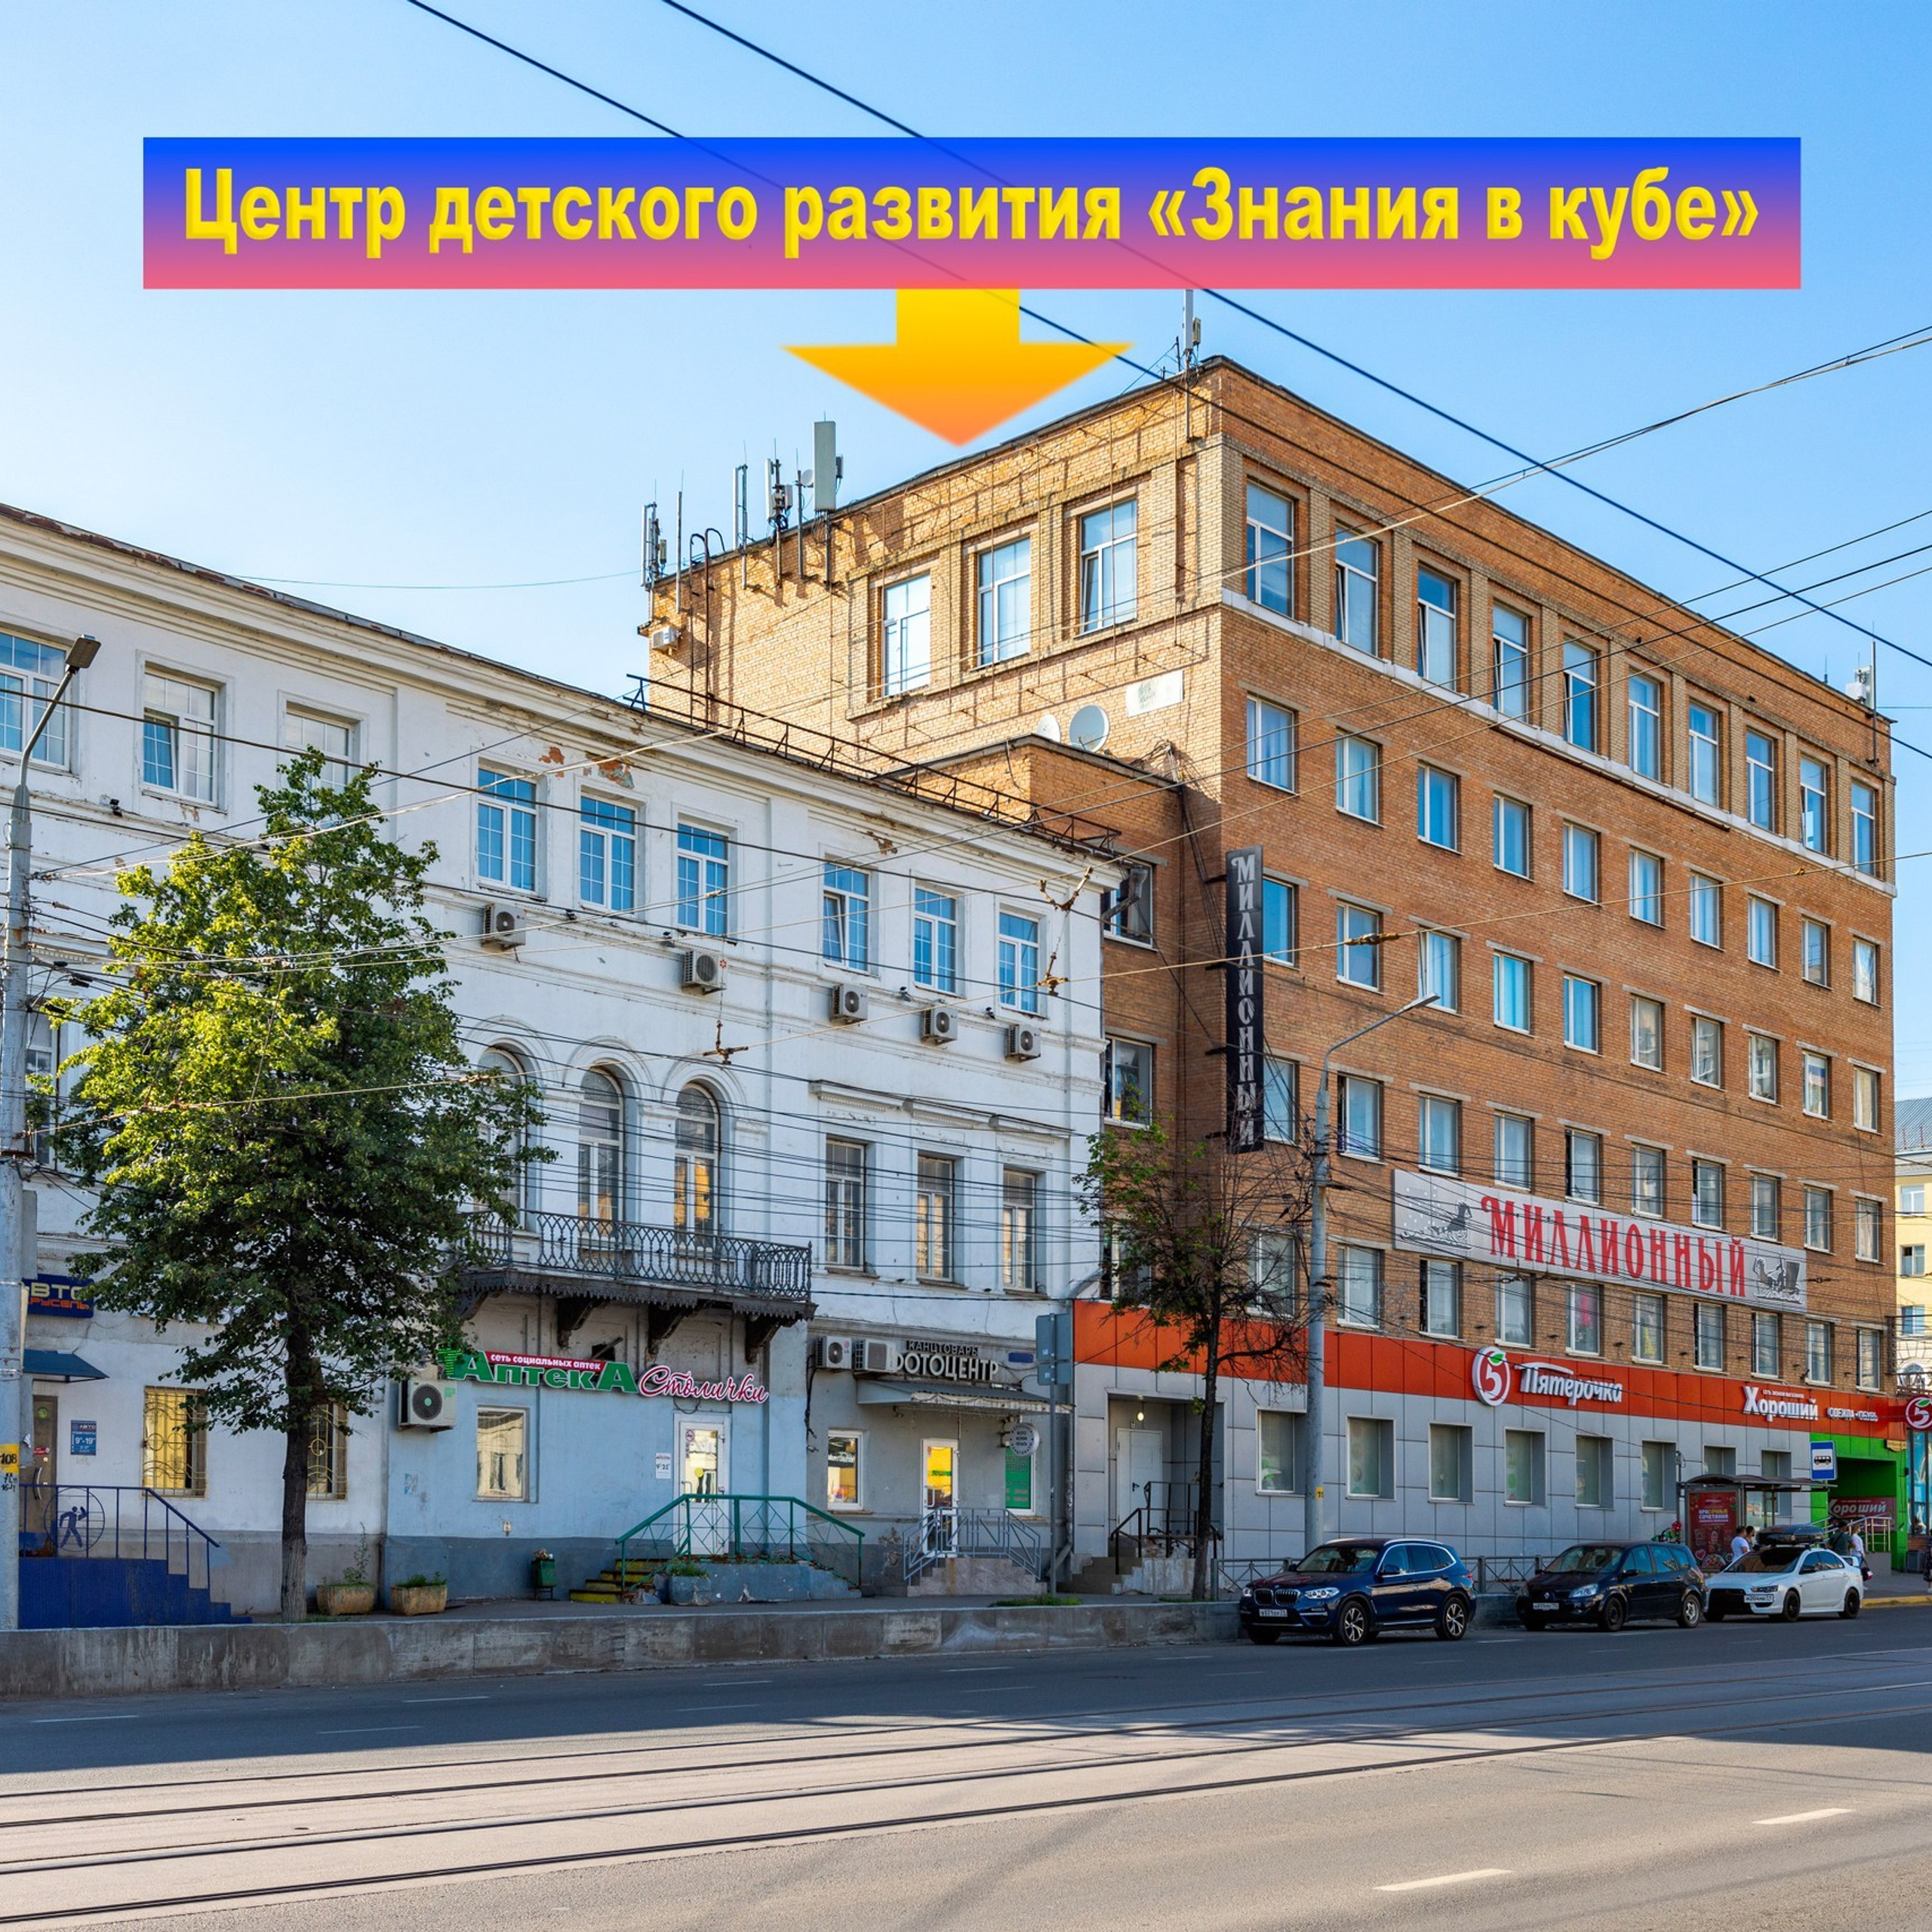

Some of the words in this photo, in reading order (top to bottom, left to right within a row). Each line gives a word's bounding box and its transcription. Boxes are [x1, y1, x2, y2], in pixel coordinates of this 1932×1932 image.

[1231, 854, 1256, 1146] МИЛЛИОННЫЙ
[1481, 1195, 1746, 1297] МИЛЛИОННЫЙ
[29, 1297, 89, 1310] РУСЕЛЬ
[31, 1282, 85, 1301] ВТО
[491, 1353, 511, 1363] сеть
[512, 1355, 572, 1367] социальных
[573, 1361, 601, 1371] аптек
[639, 1364, 770, 1404] Столички
[1743, 1386, 1818, 1422] Хороший
